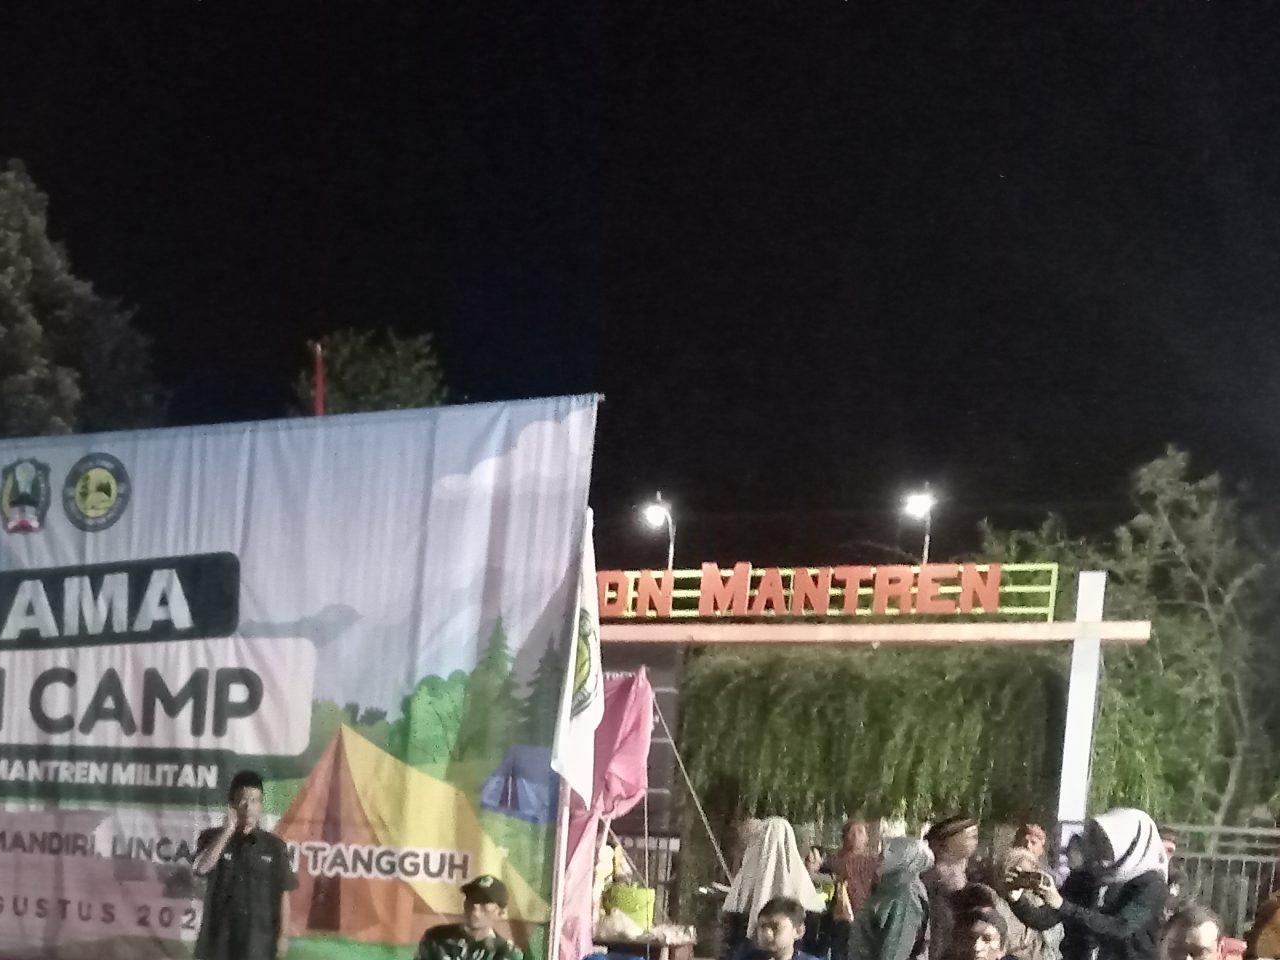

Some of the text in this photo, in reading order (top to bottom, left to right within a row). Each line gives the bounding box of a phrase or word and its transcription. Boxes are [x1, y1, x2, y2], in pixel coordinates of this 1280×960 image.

[698, 560, 1001, 616] MANTREN
[29, 666, 264, 738] CAMP
[112, 762, 218, 789] MILITAN
[111, 834, 195, 864] LINCA
[305, 845, 469, 880] TANGGUH
[135, 903, 197, 929] 202
